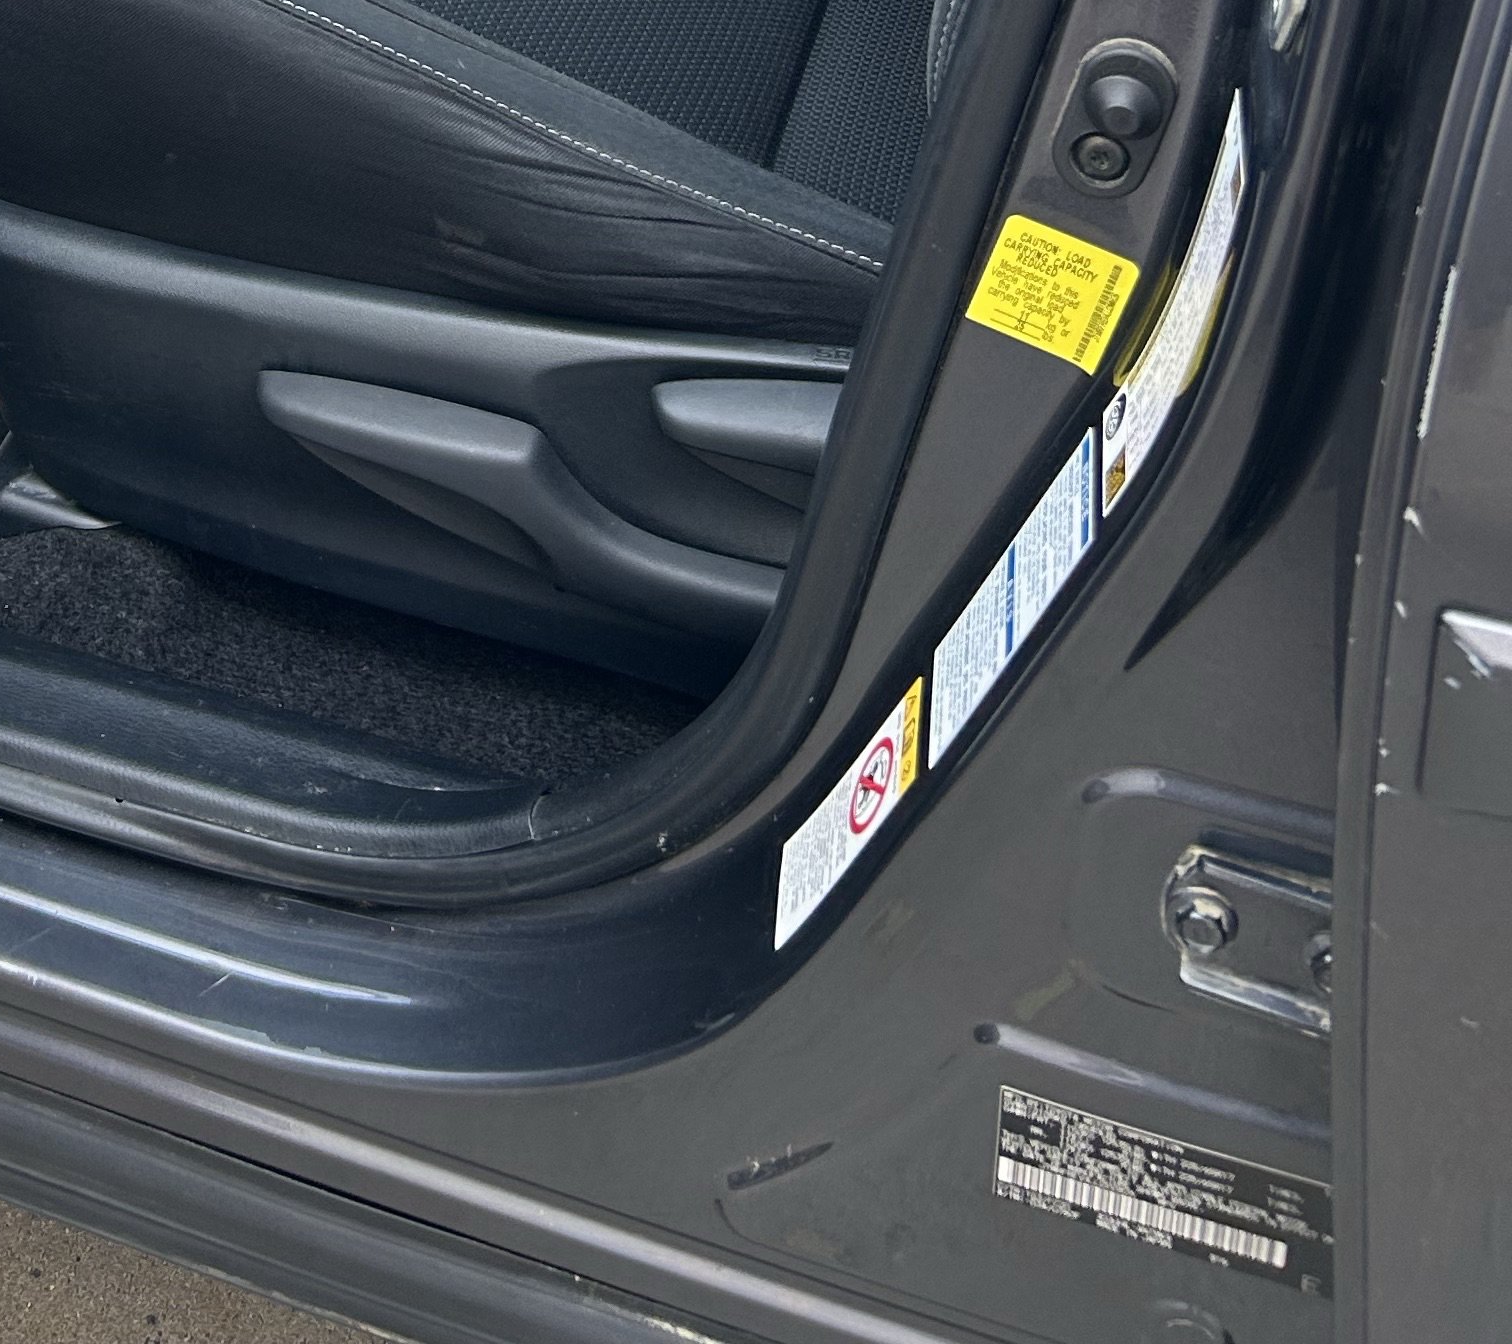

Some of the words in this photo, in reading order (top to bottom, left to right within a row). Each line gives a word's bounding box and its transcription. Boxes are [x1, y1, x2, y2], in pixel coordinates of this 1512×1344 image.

[1004, 237, 1049, 263] CARRYING
[1053, 258, 1099, 283] CAPACITY
[1016, 253, 1058, 277] REDUCED
[1066, 251, 1091, 268] LOAD
